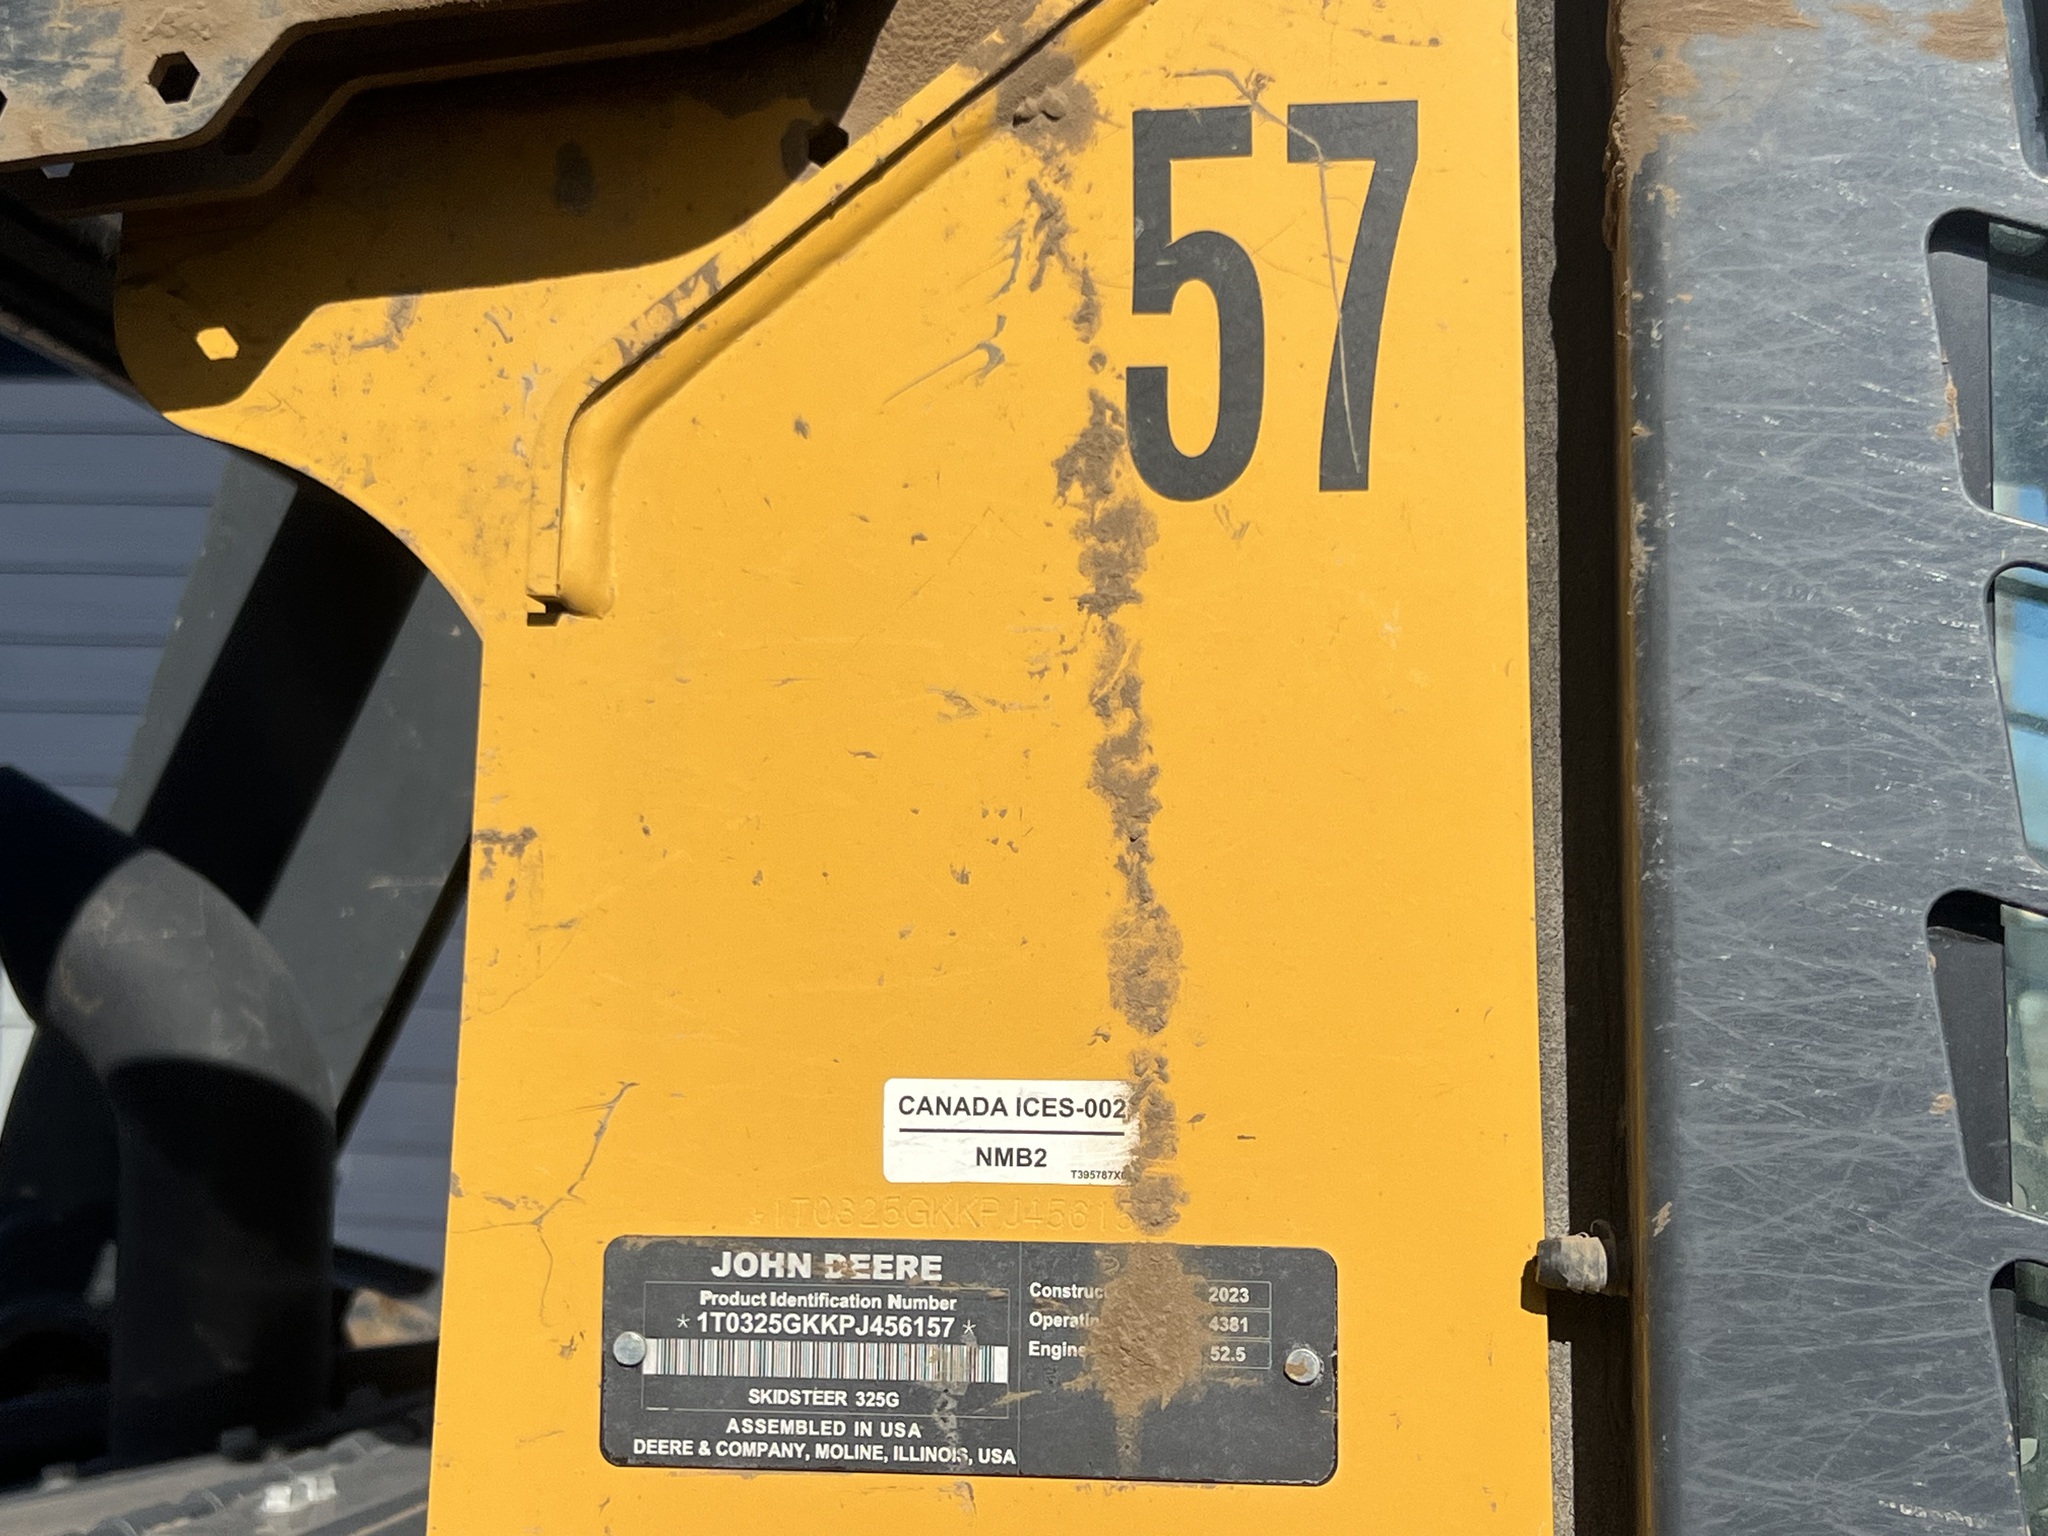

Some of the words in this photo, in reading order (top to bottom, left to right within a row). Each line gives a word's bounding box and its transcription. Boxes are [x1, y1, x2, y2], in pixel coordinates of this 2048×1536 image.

[1126, 99, 1418, 502] 57
[898, 1095, 1009, 1118] CANADA
[1016, 1096, 1126, 1119] ICES-002
[975, 1147, 1047, 1168] NMB2
[749, 1195, 1136, 1231] 1T0325GKKPJ45615
[711, 1251, 812, 1279] JOHN
[825, 1253, 943, 1281] DEERE
[700, 1289, 767, 1307] Product
[770, 1291, 882, 1309] Identification
[887, 1294, 957, 1311] Number
[1029, 1281, 1105, 1300] Construc
[1208, 1286, 1250, 1303] 2023
[1029, 1311, 1099, 1331] Operatin
[1208, 1317, 1249, 1333] 4381
[1210, 1346, 1247, 1363] 52.5
[748, 1388, 848, 1407] SKIDSTEER
[855, 1391, 900, 1408] 325G
[726, 1417, 846, 1437] ASSEMBLED
[854, 1421, 873, 1437] IN
[880, 1421, 922, 1439] USA
[633, 1438, 694, 1456] DEERE
[698, 1439, 711, 1457] &
[715, 1440, 810, 1461] COMPANY,
[815, 1443, 888, 1464] MOLINE,
[893, 1446, 974, 1466] ILLINOIS,
[978, 1447, 1017, 1465] USA
